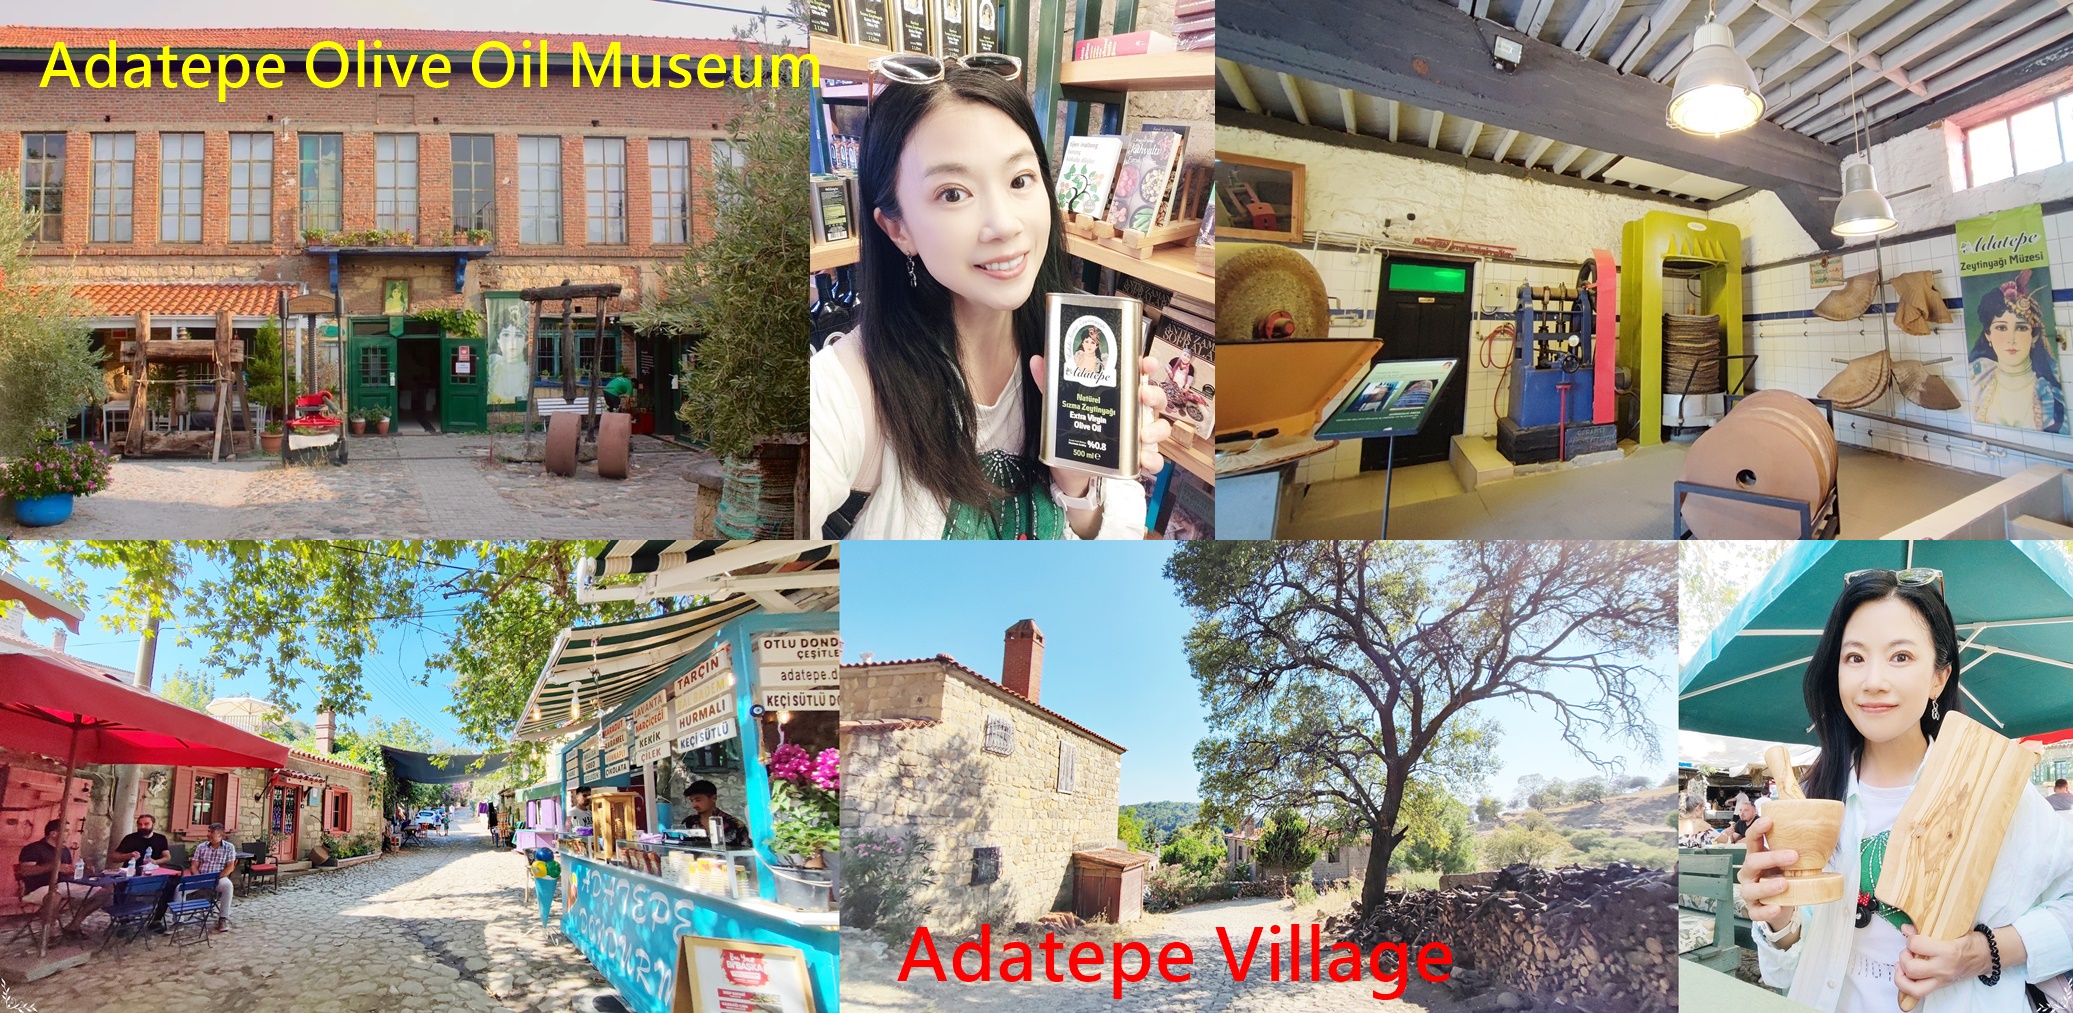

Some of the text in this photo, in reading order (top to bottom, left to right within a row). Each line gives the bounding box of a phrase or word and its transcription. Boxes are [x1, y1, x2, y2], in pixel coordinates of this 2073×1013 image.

[1960, 232, 2038, 254] Adatepe
[1960, 252, 2044, 272] Zeytinyağı Müzesi
[1065, 366, 1112, 385] Adatepe
[1076, 393, 1101, 404] Natürel
[1062, 400, 1116, 416] Sızma Zeytinyağı
[1069, 411, 1107, 425] Extra Virgin
[1073, 422, 1102, 433] Olive Oil
[1073, 449, 1086, 458] 500
[1086, 451, 1094, 459] ml
[1087, 440, 1107, 451] %0.8
[763, 637, 839, 649] OTLU DOND
[797, 648, 839, 660] ÇEŞİTLE
[677, 656, 719, 690] TARÇIN
[781, 668, 838, 683] adatepe.d
[677, 678, 725, 711] BAL BADEM
[766, 692, 791, 709] KEÇİ
[793, 692, 826, 707] SÜTLÜ
[634, 694, 663, 719] LAVANTA
[679, 699, 726, 730] HURMALI
[635, 708, 664, 734] NARÇİÇEĞİ
[639, 731, 661, 748] KEKİK
[680, 721, 729, 750] KEÇİ SÜTLÜ
[640, 747, 662, 763] ÇİLEK
[582, 869, 695, 946] ADATEPE
